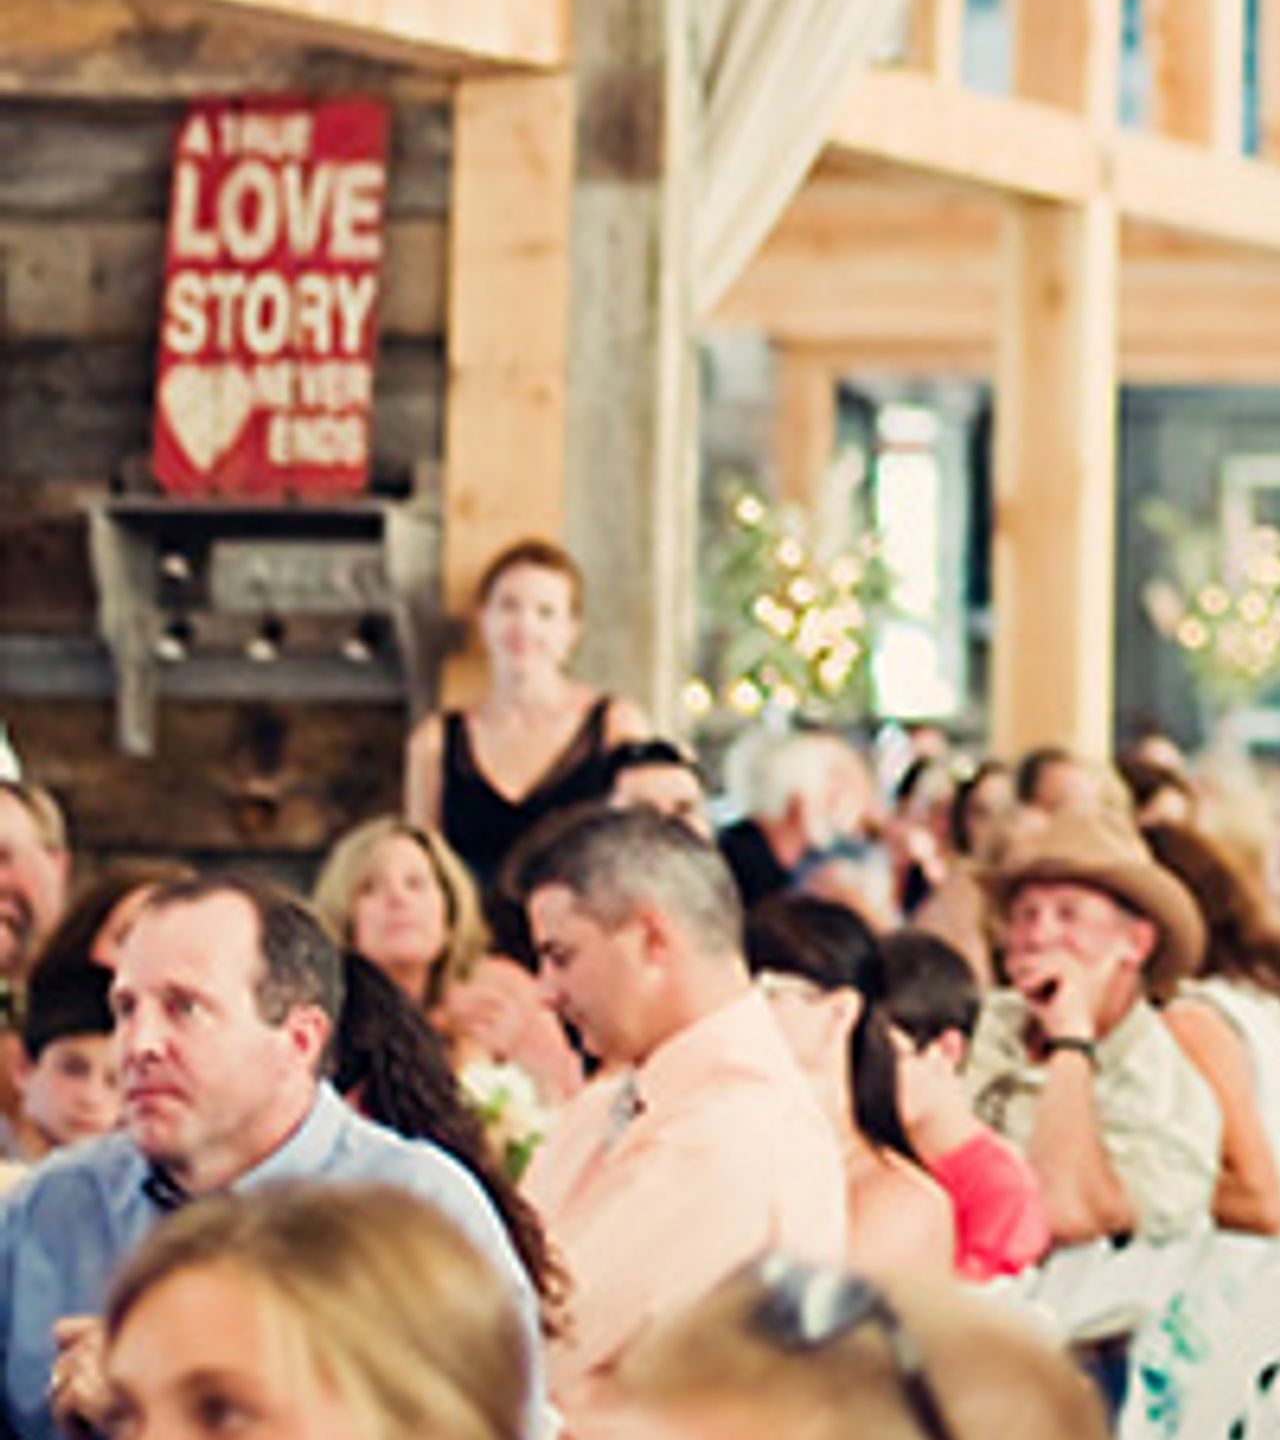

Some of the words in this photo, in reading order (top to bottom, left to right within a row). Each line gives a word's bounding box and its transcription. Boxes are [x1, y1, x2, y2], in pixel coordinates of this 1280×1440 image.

[181, 113, 210, 157] A
[174, 159, 386, 261] LOVE
[165, 270, 377, 354] STORY
